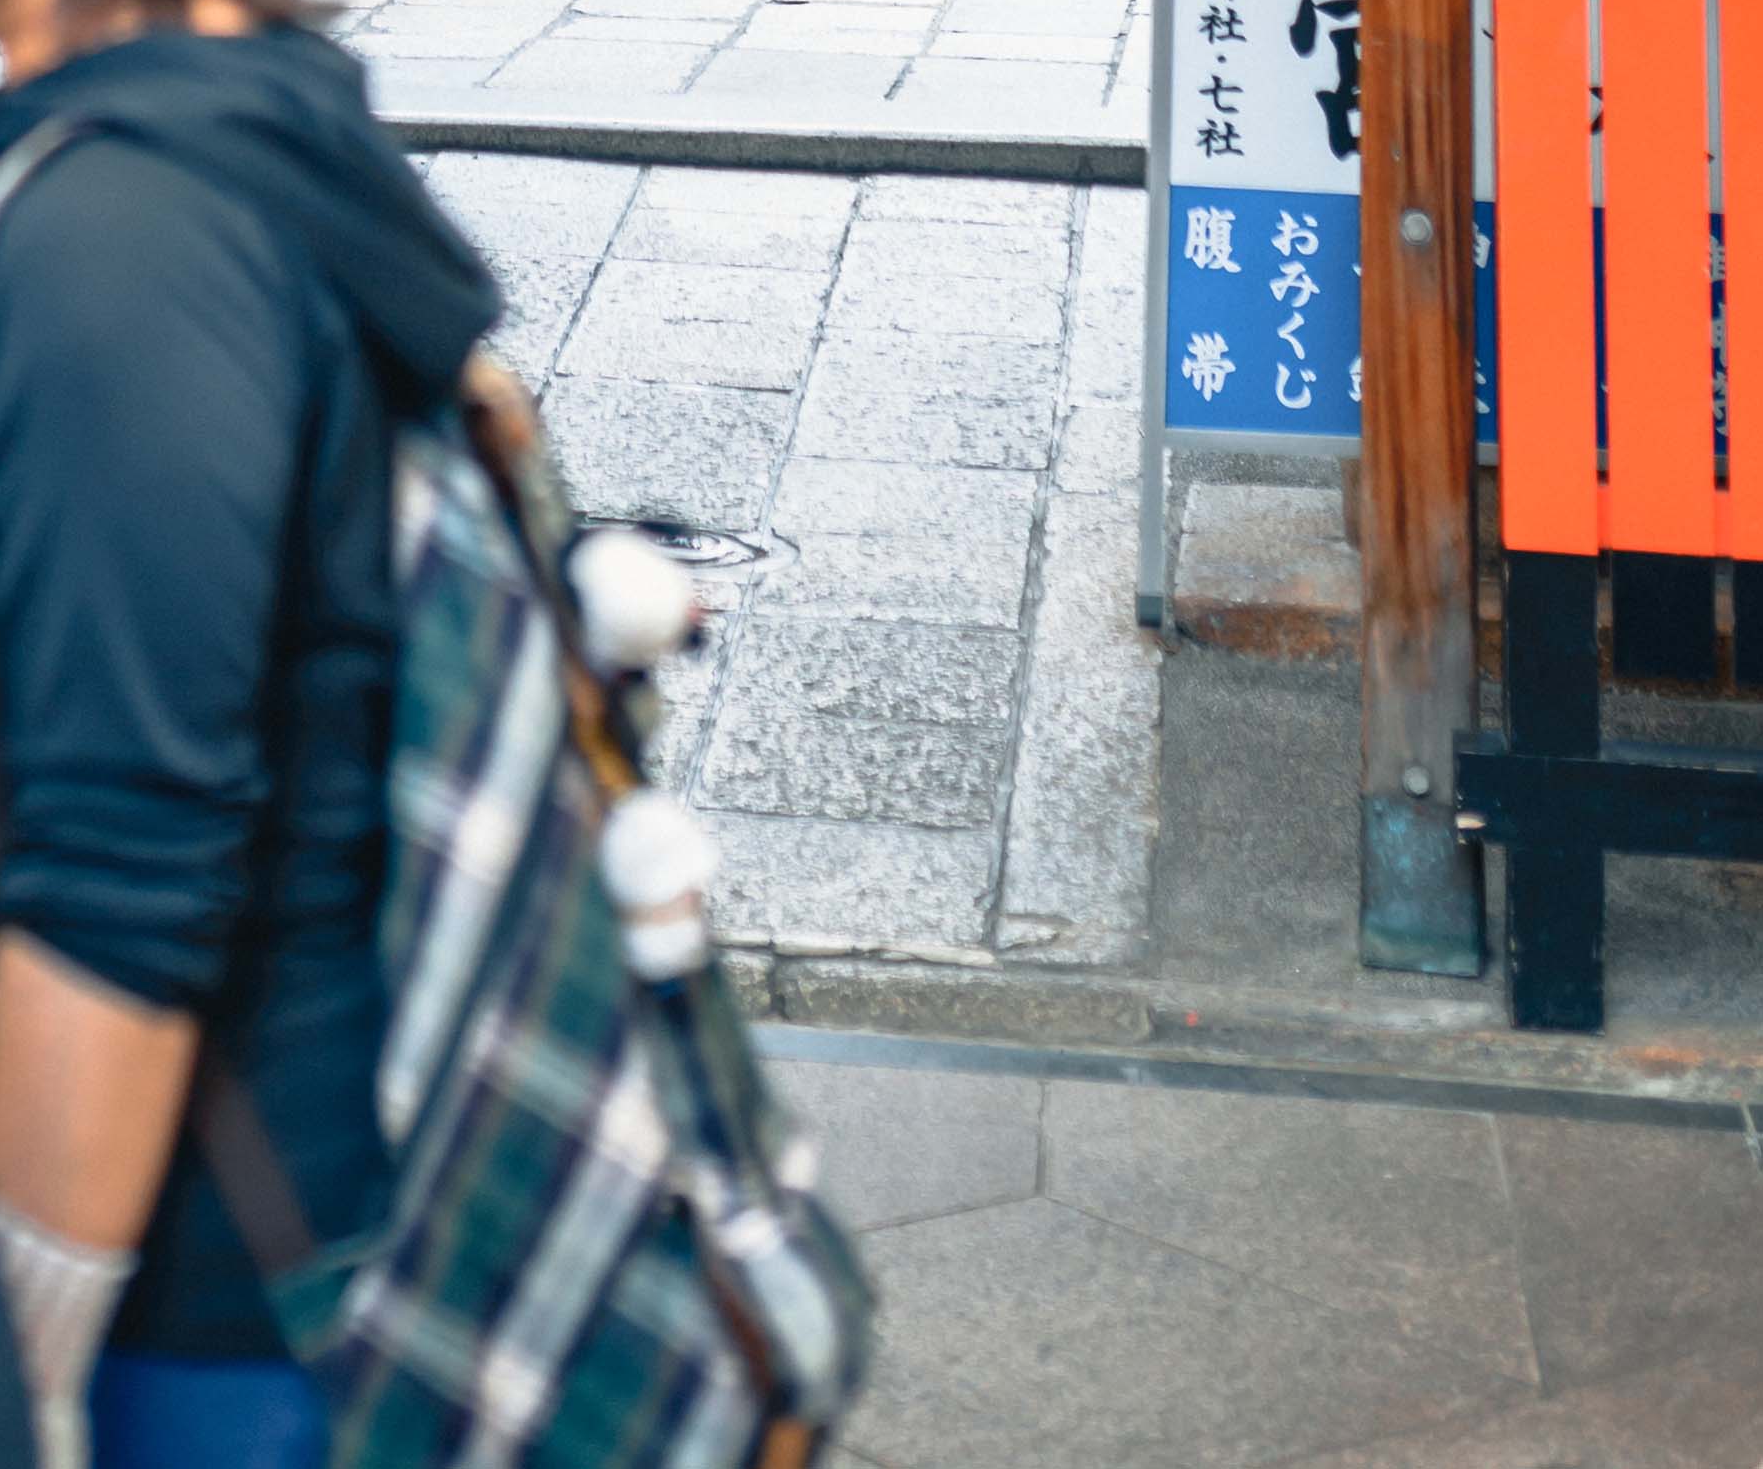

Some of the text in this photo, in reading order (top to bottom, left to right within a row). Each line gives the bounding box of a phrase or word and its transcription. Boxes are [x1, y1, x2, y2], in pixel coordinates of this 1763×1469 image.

[1181, 205, 1243, 404] 腹帯
[1269, 209, 1321, 411] おみくじ
